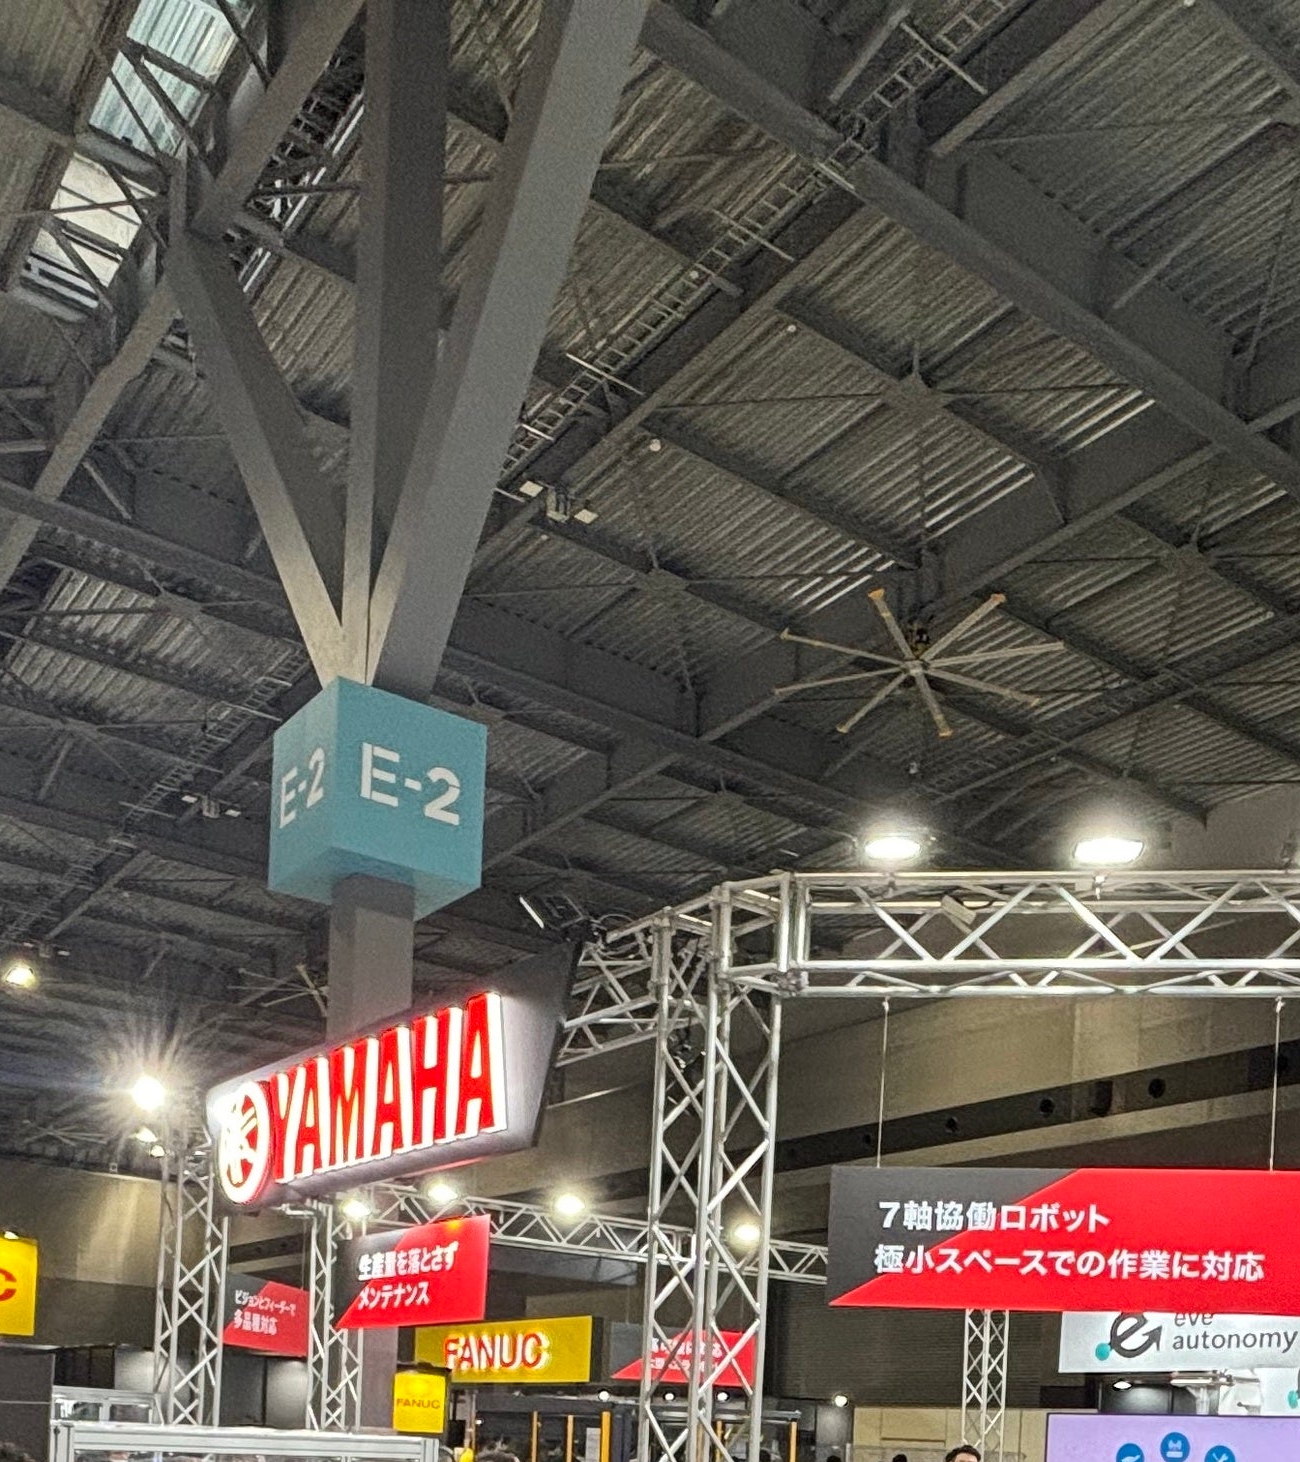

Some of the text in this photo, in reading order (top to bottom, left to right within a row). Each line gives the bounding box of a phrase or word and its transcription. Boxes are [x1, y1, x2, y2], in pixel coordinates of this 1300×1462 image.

[278, 747, 327, 829] E-2
[360, 742, 462, 826] E-2
[268, 990, 508, 1185] YAMAHA
[878, 1200, 1111, 1233] 7軸協働ロボット
[357, 1240, 460, 1282] 生産量を落とさず
[873, 1243, 1267, 1283] 極小スペースでの作業に対応
[357, 1281, 430, 1311] メンテナンス
[1174, 1313, 1214, 1327] eve
[443, 1331, 549, 1372] FANUC
[1171, 1329, 1299, 1354] autonomy
[397, 1398, 441, 1410] FANUC
